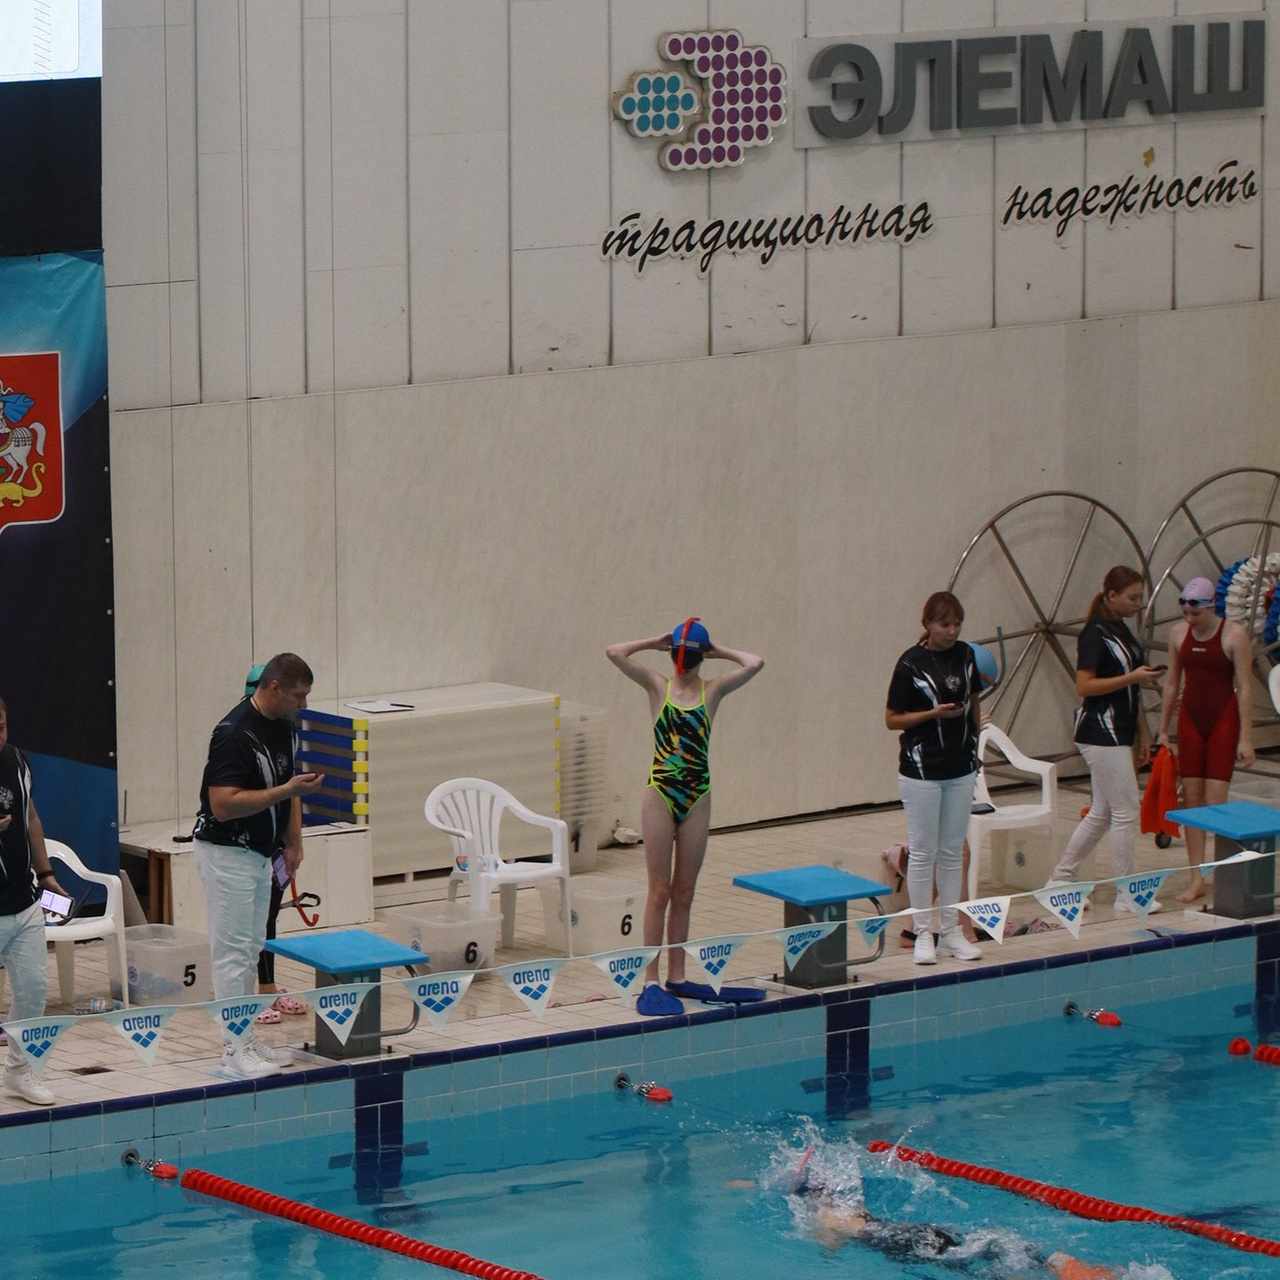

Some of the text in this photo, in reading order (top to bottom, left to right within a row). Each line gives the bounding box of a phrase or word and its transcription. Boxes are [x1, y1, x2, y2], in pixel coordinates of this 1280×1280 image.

[807, 19, 1266, 140] ЭЛЕМАШ
[601, 160, 1259, 273] традиционная надежность
[1129, 876, 1161, 894] arena
[966, 902, 1002, 915] arena
[1050, 891, 1082, 908] arena
[621, 913, 632, 936] 6
[787, 929, 822, 945] arena
[464, 941, 478, 964] 6
[699, 943, 732, 961] arena
[608, 956, 643, 974] arena
[183, 963, 197, 987] 5
[513, 968, 551, 985] arena
[418, 980, 459, 997] arena
[320, 991, 357, 1009] arena
[221, 1003, 259, 1021] arena
[122, 1014, 161, 1032] arena
[22, 1025, 59, 1042] arena
